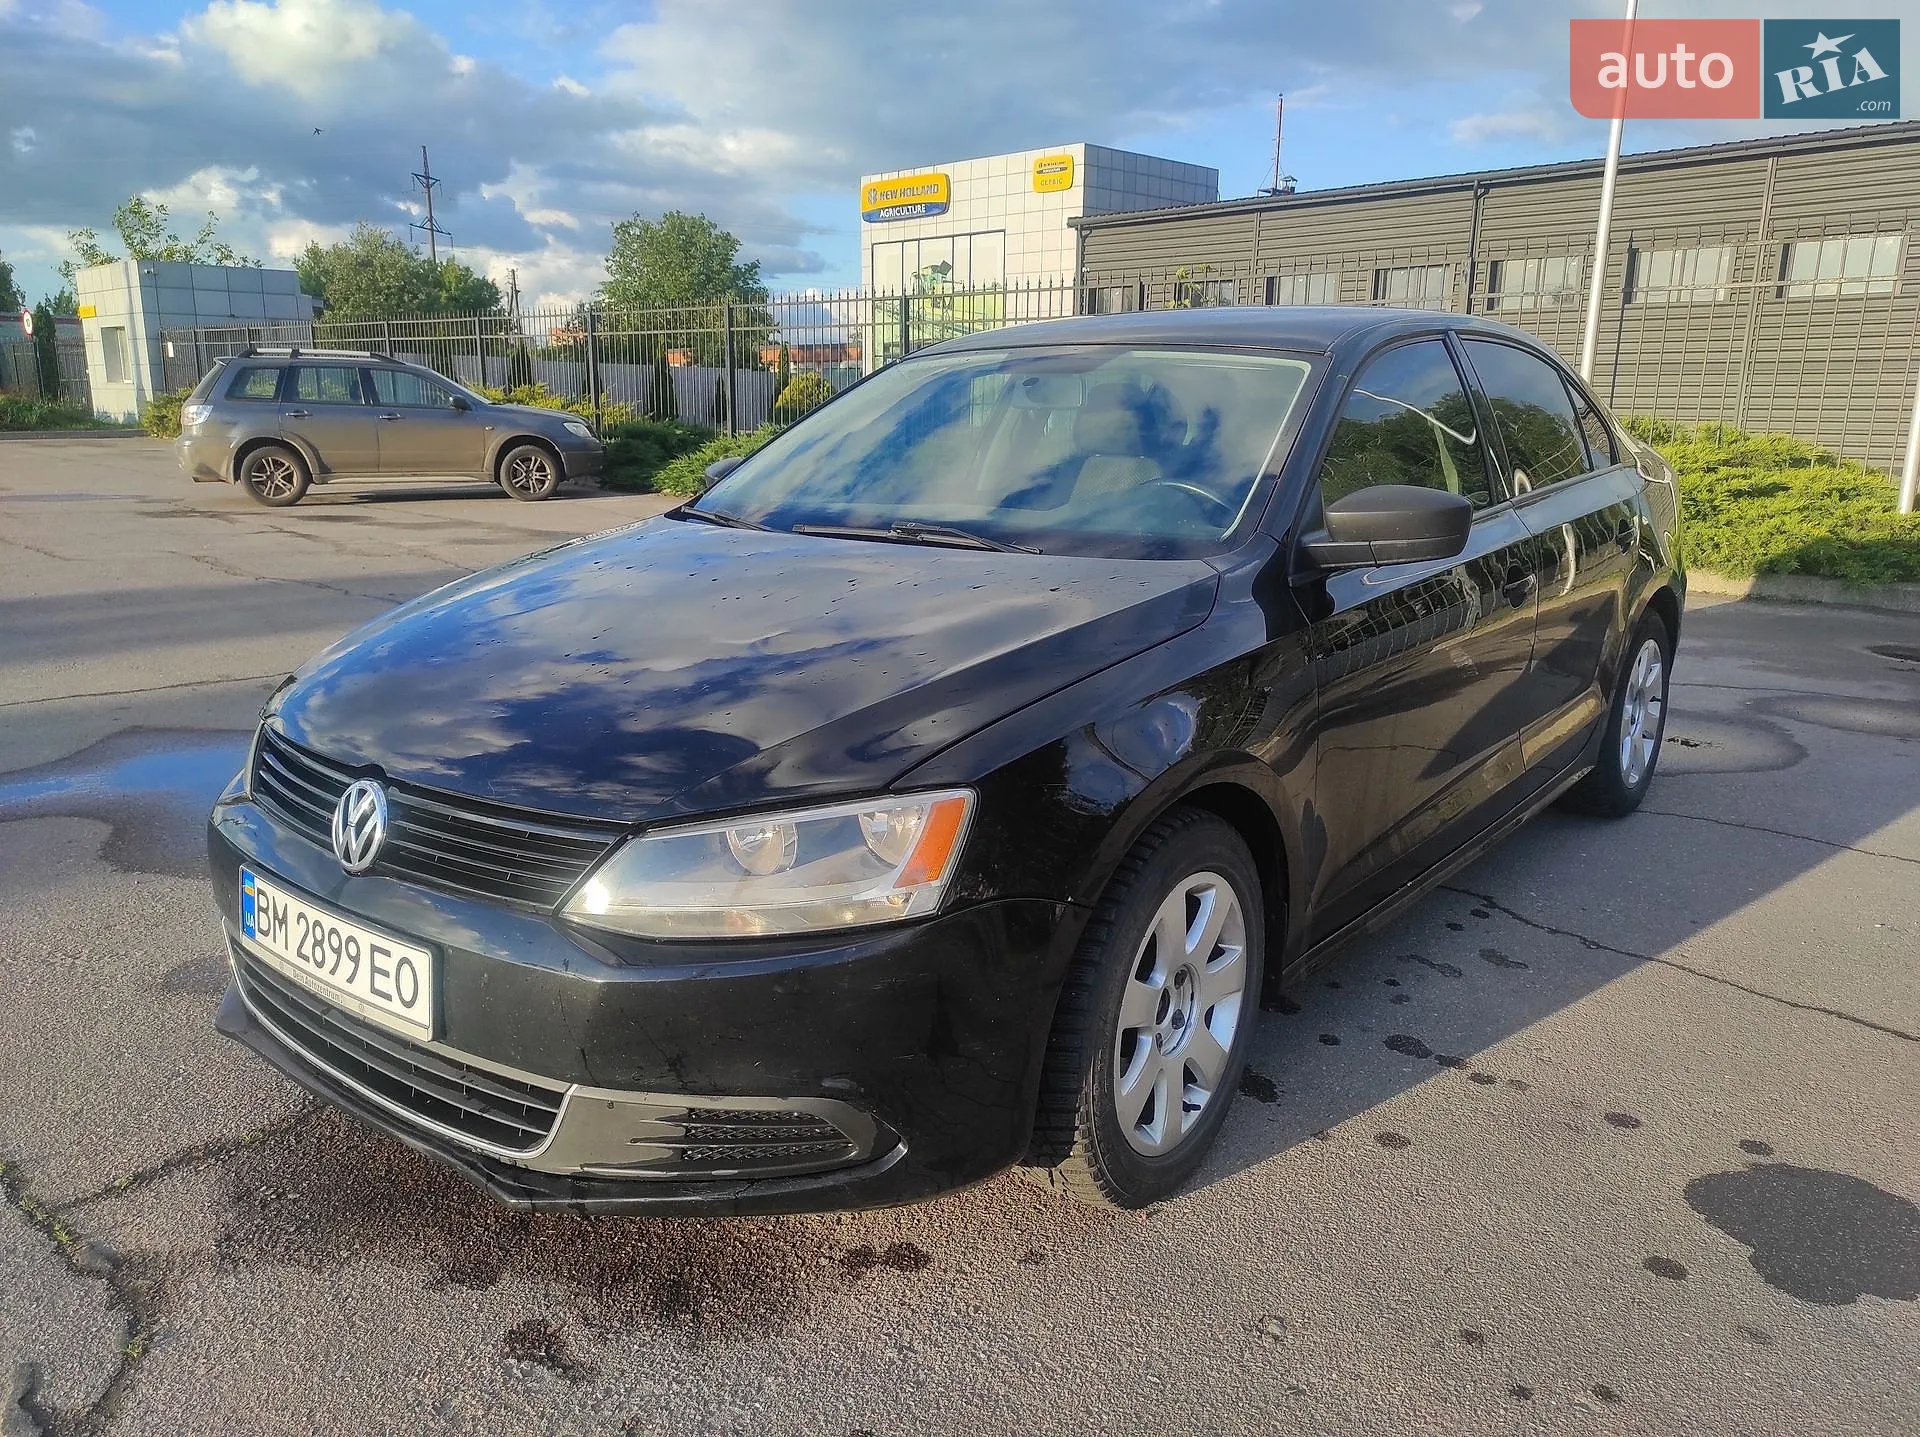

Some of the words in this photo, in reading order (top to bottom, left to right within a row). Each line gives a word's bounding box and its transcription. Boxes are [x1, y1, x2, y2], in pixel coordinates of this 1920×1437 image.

[880, 188, 897, 201] NEW
[900, 184, 939, 198] HOLLAND
[880, 204, 926, 218] AGRICULTURE
[245, 911, 255, 930] UA
[256, 887, 289, 951] BM
[296, 911, 361, 985] 2899
[370, 943, 419, 1009] EO
